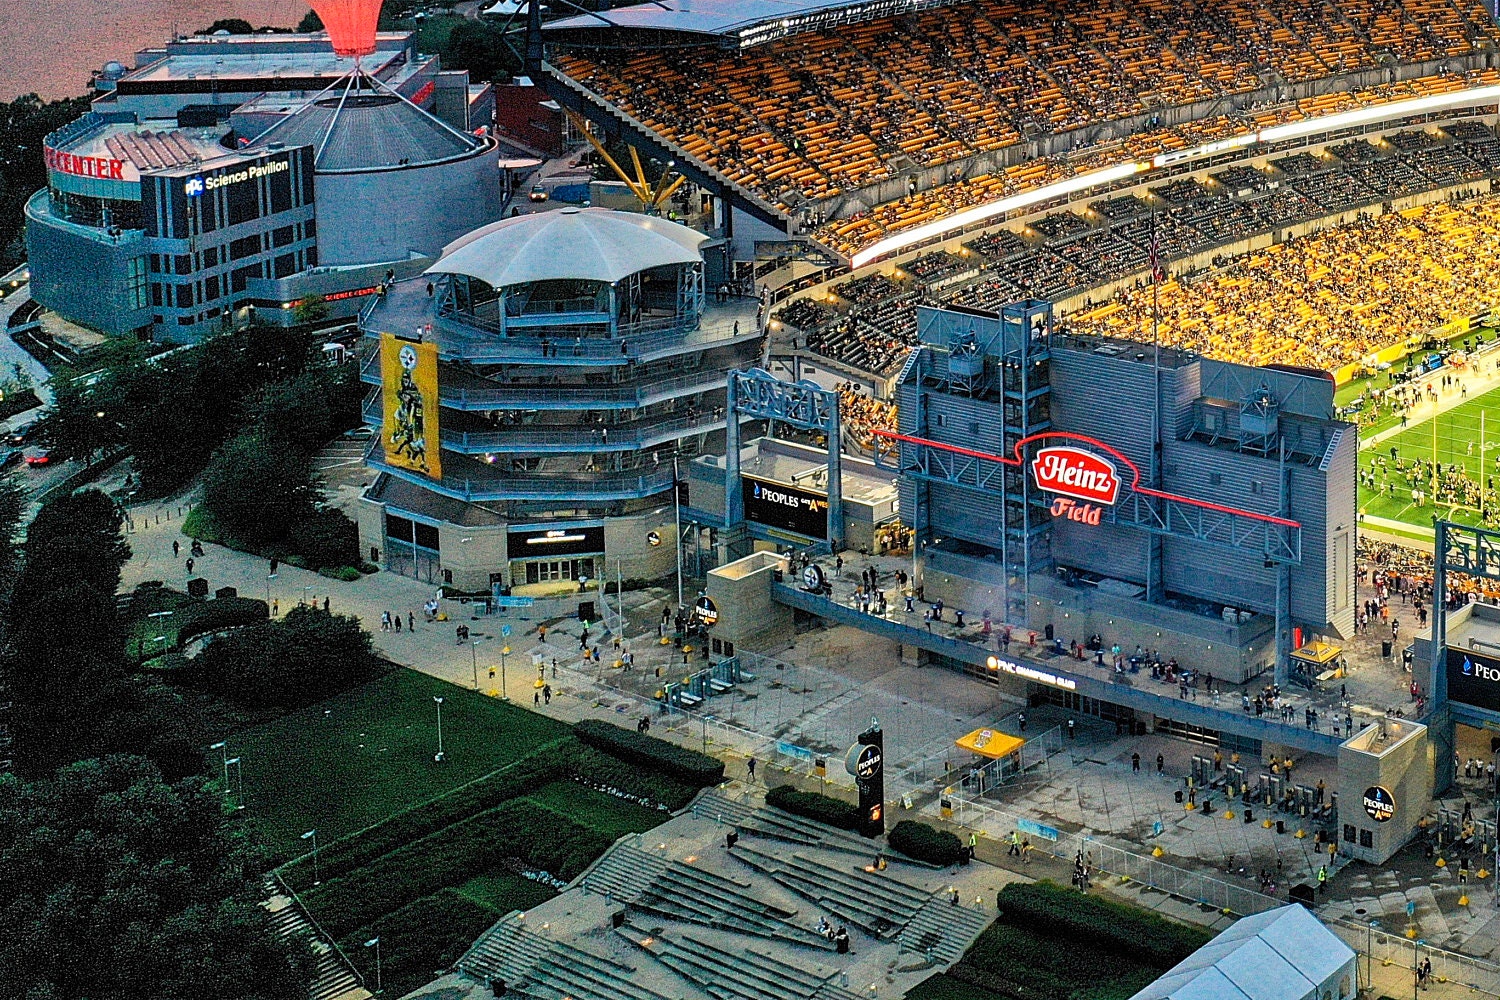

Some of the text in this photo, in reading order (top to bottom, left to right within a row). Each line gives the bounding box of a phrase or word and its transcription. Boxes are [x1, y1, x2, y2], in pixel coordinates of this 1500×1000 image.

[55, 150, 123, 180] CENTER
[205, 167, 249, 190] Science
[249, 159, 288, 180] Pavilion
[1040, 455, 1111, 492] Heinz
[761, 487, 798, 508] PEOPLES
[809, 499, 818, 512] A
[817, 500, 829, 509] WES
[1050, 497, 1102, 526] Field
[997, 659, 1016, 674] PNC
[859, 754, 880, 770] PEOPLES
[1363, 796, 1394, 813] PEOPLES
